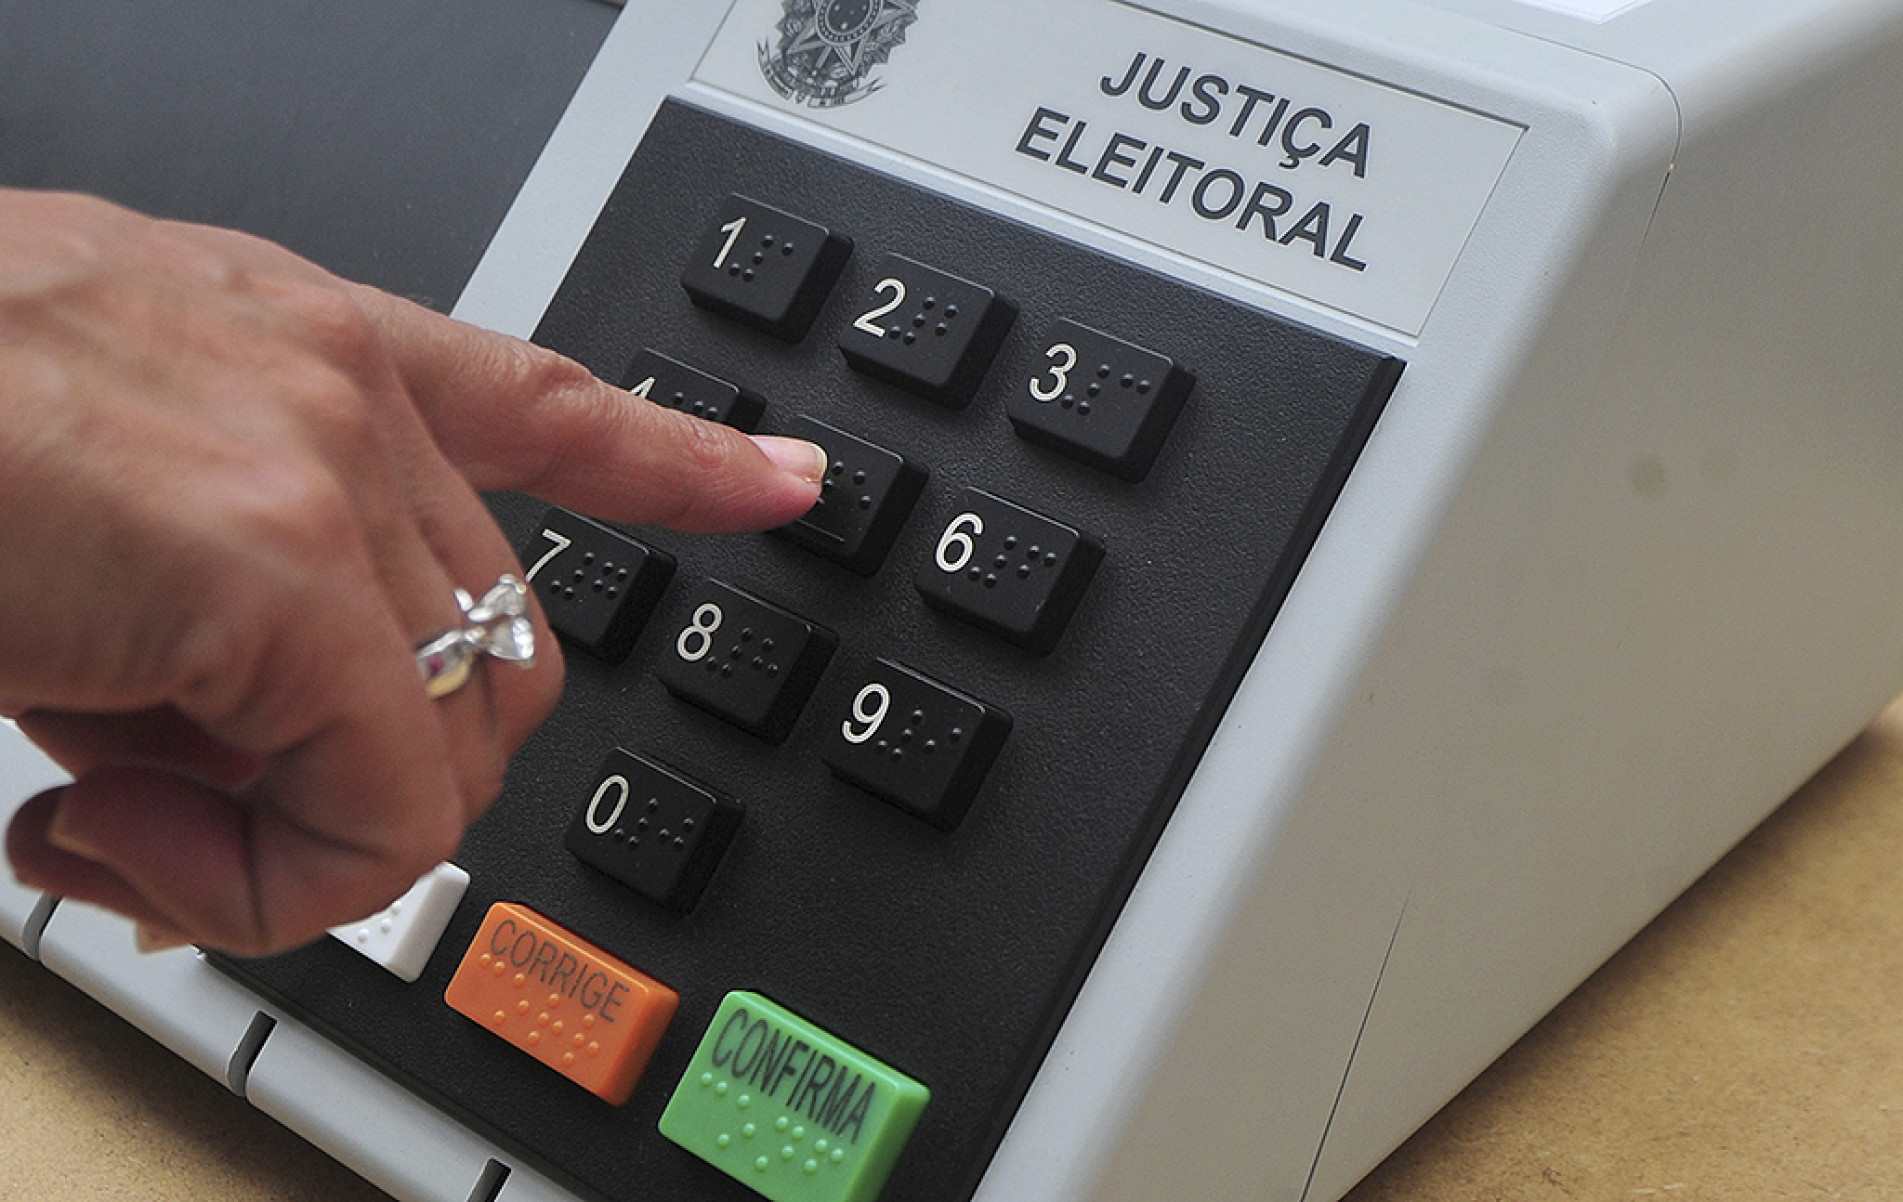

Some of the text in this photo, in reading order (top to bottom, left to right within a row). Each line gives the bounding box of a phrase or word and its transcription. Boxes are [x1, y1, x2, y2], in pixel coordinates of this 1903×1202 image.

[1101, 52, 1371, 178] JUSTIÇA
[1016, 107, 1367, 271] ELEITORAL
[713, 217, 746, 269] 1
[853, 278, 906, 337] 2
[1029, 343, 1077, 401] 3
[525, 529, 571, 582] 7
[935, 513, 983, 572] 6
[676, 603, 722, 661] 8
[842, 684, 890, 743] 9
[585, 775, 629, 834] 0
[490, 919, 630, 1023] CORRIGE
[711, 1008, 876, 1145] CONFIRMA
